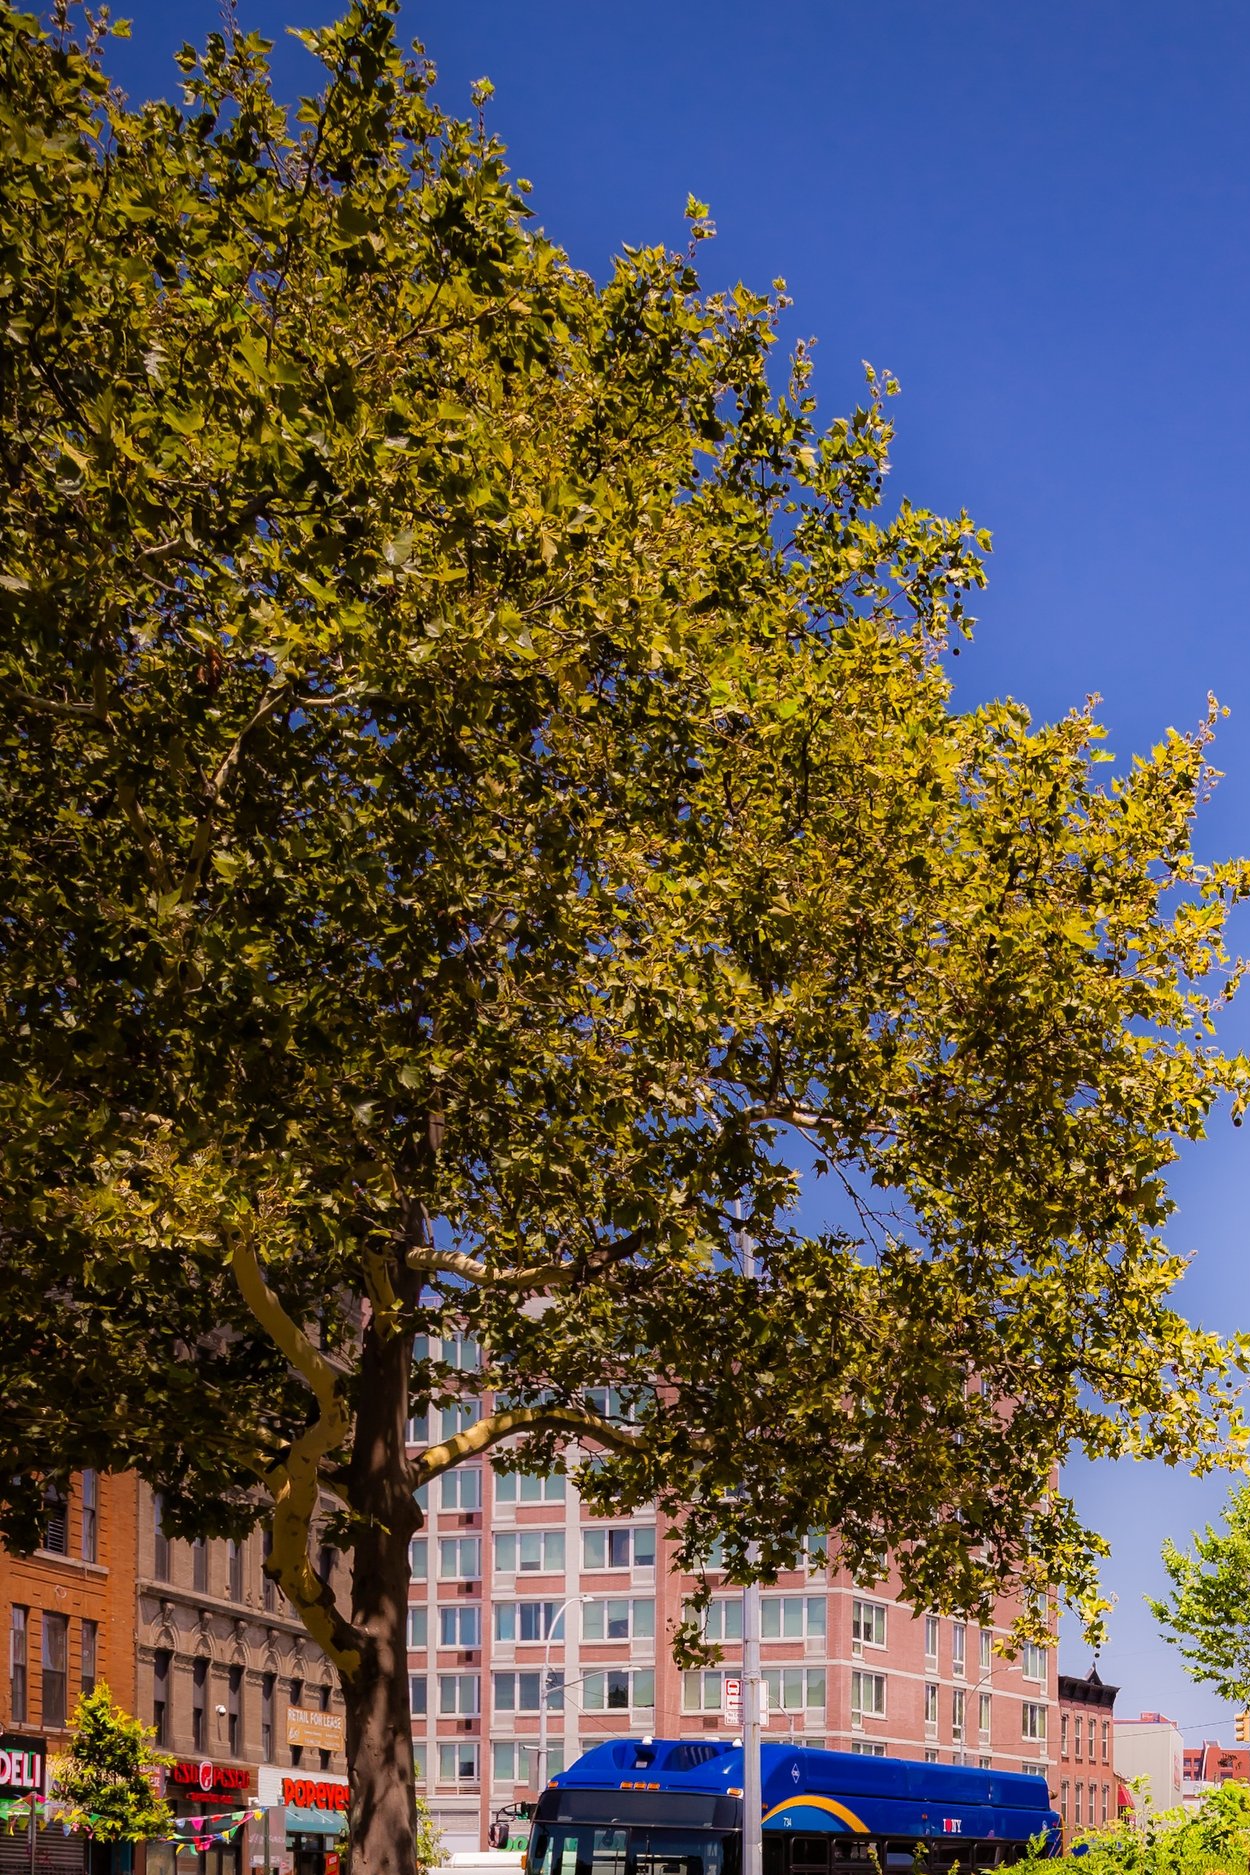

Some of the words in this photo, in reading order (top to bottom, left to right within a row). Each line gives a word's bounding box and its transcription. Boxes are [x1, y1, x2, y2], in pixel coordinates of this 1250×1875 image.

[287, 1708, 309, 1724] RETAIL
[324, 1715, 341, 1729] LEASE
[0, 1748, 41, 1788] DELI
